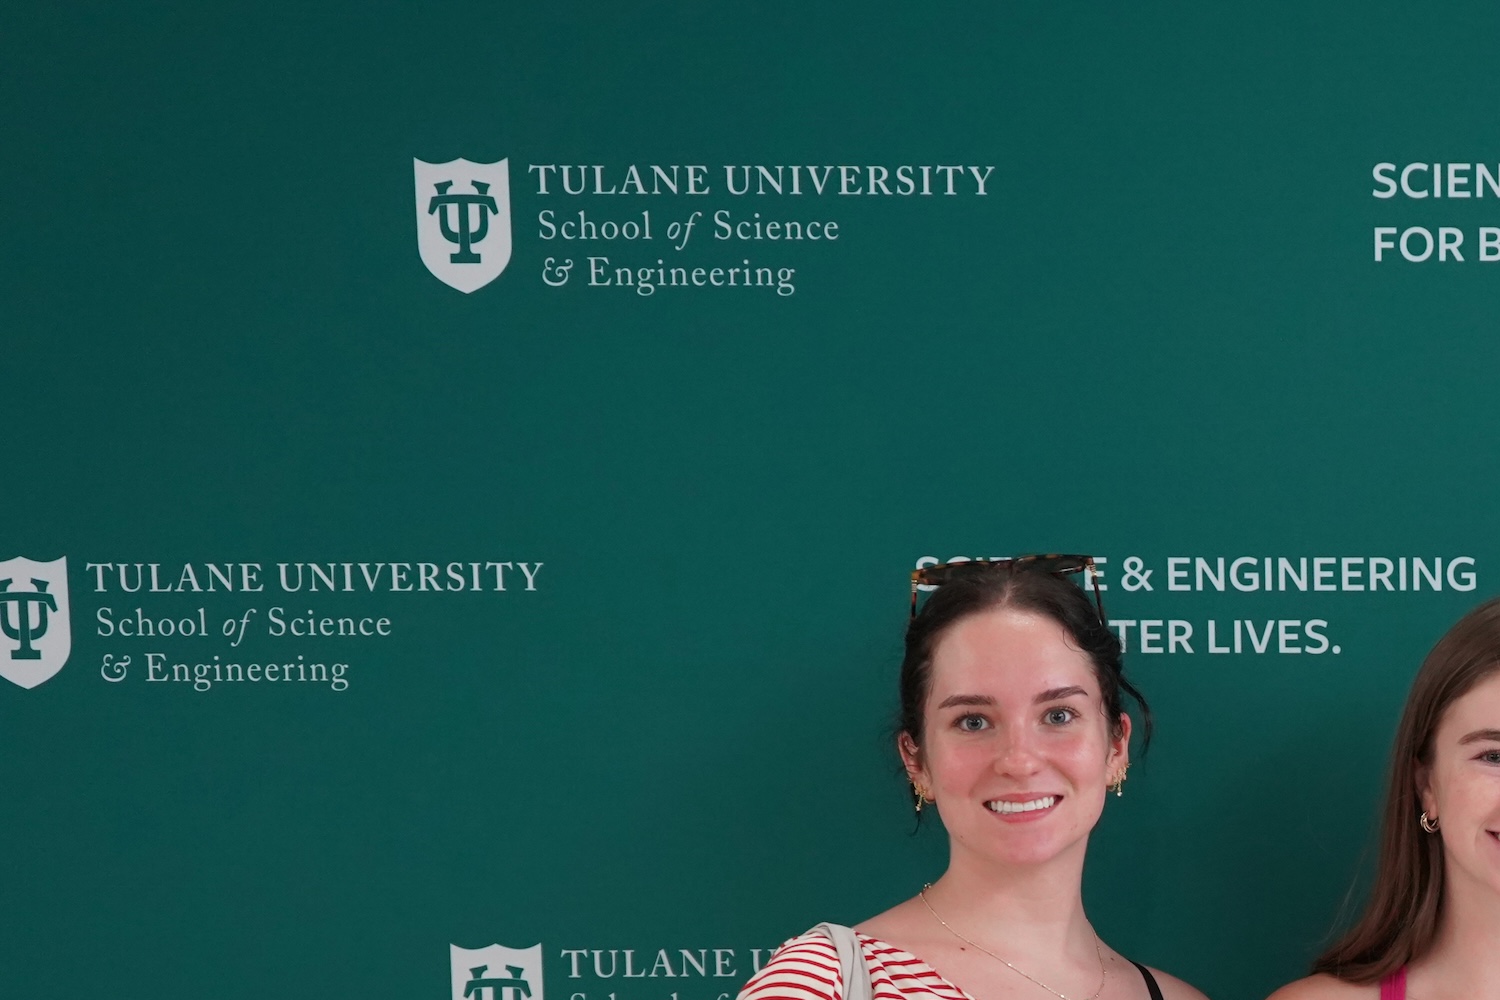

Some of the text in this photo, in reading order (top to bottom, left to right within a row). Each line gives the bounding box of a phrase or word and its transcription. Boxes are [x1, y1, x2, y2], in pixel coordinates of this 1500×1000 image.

[528, 164, 995, 196] TULANE UNIVERSITY
[538, 209, 839, 251] School of Science
[1374, 226, 1465, 263] FOR
[542, 256, 796, 297] & Engineering
[85, 561, 544, 593] TULANE UNIVERSITY
[1120, 556, 1154, 592] &
[1167, 556, 1477, 592] ENGINEERING
[96, 606, 391, 647] School of Science
[1107, 618, 1342, 655] TER LIVES.
[100, 653, 349, 692] & Engineering
[560, 948, 737, 979] TULANE
